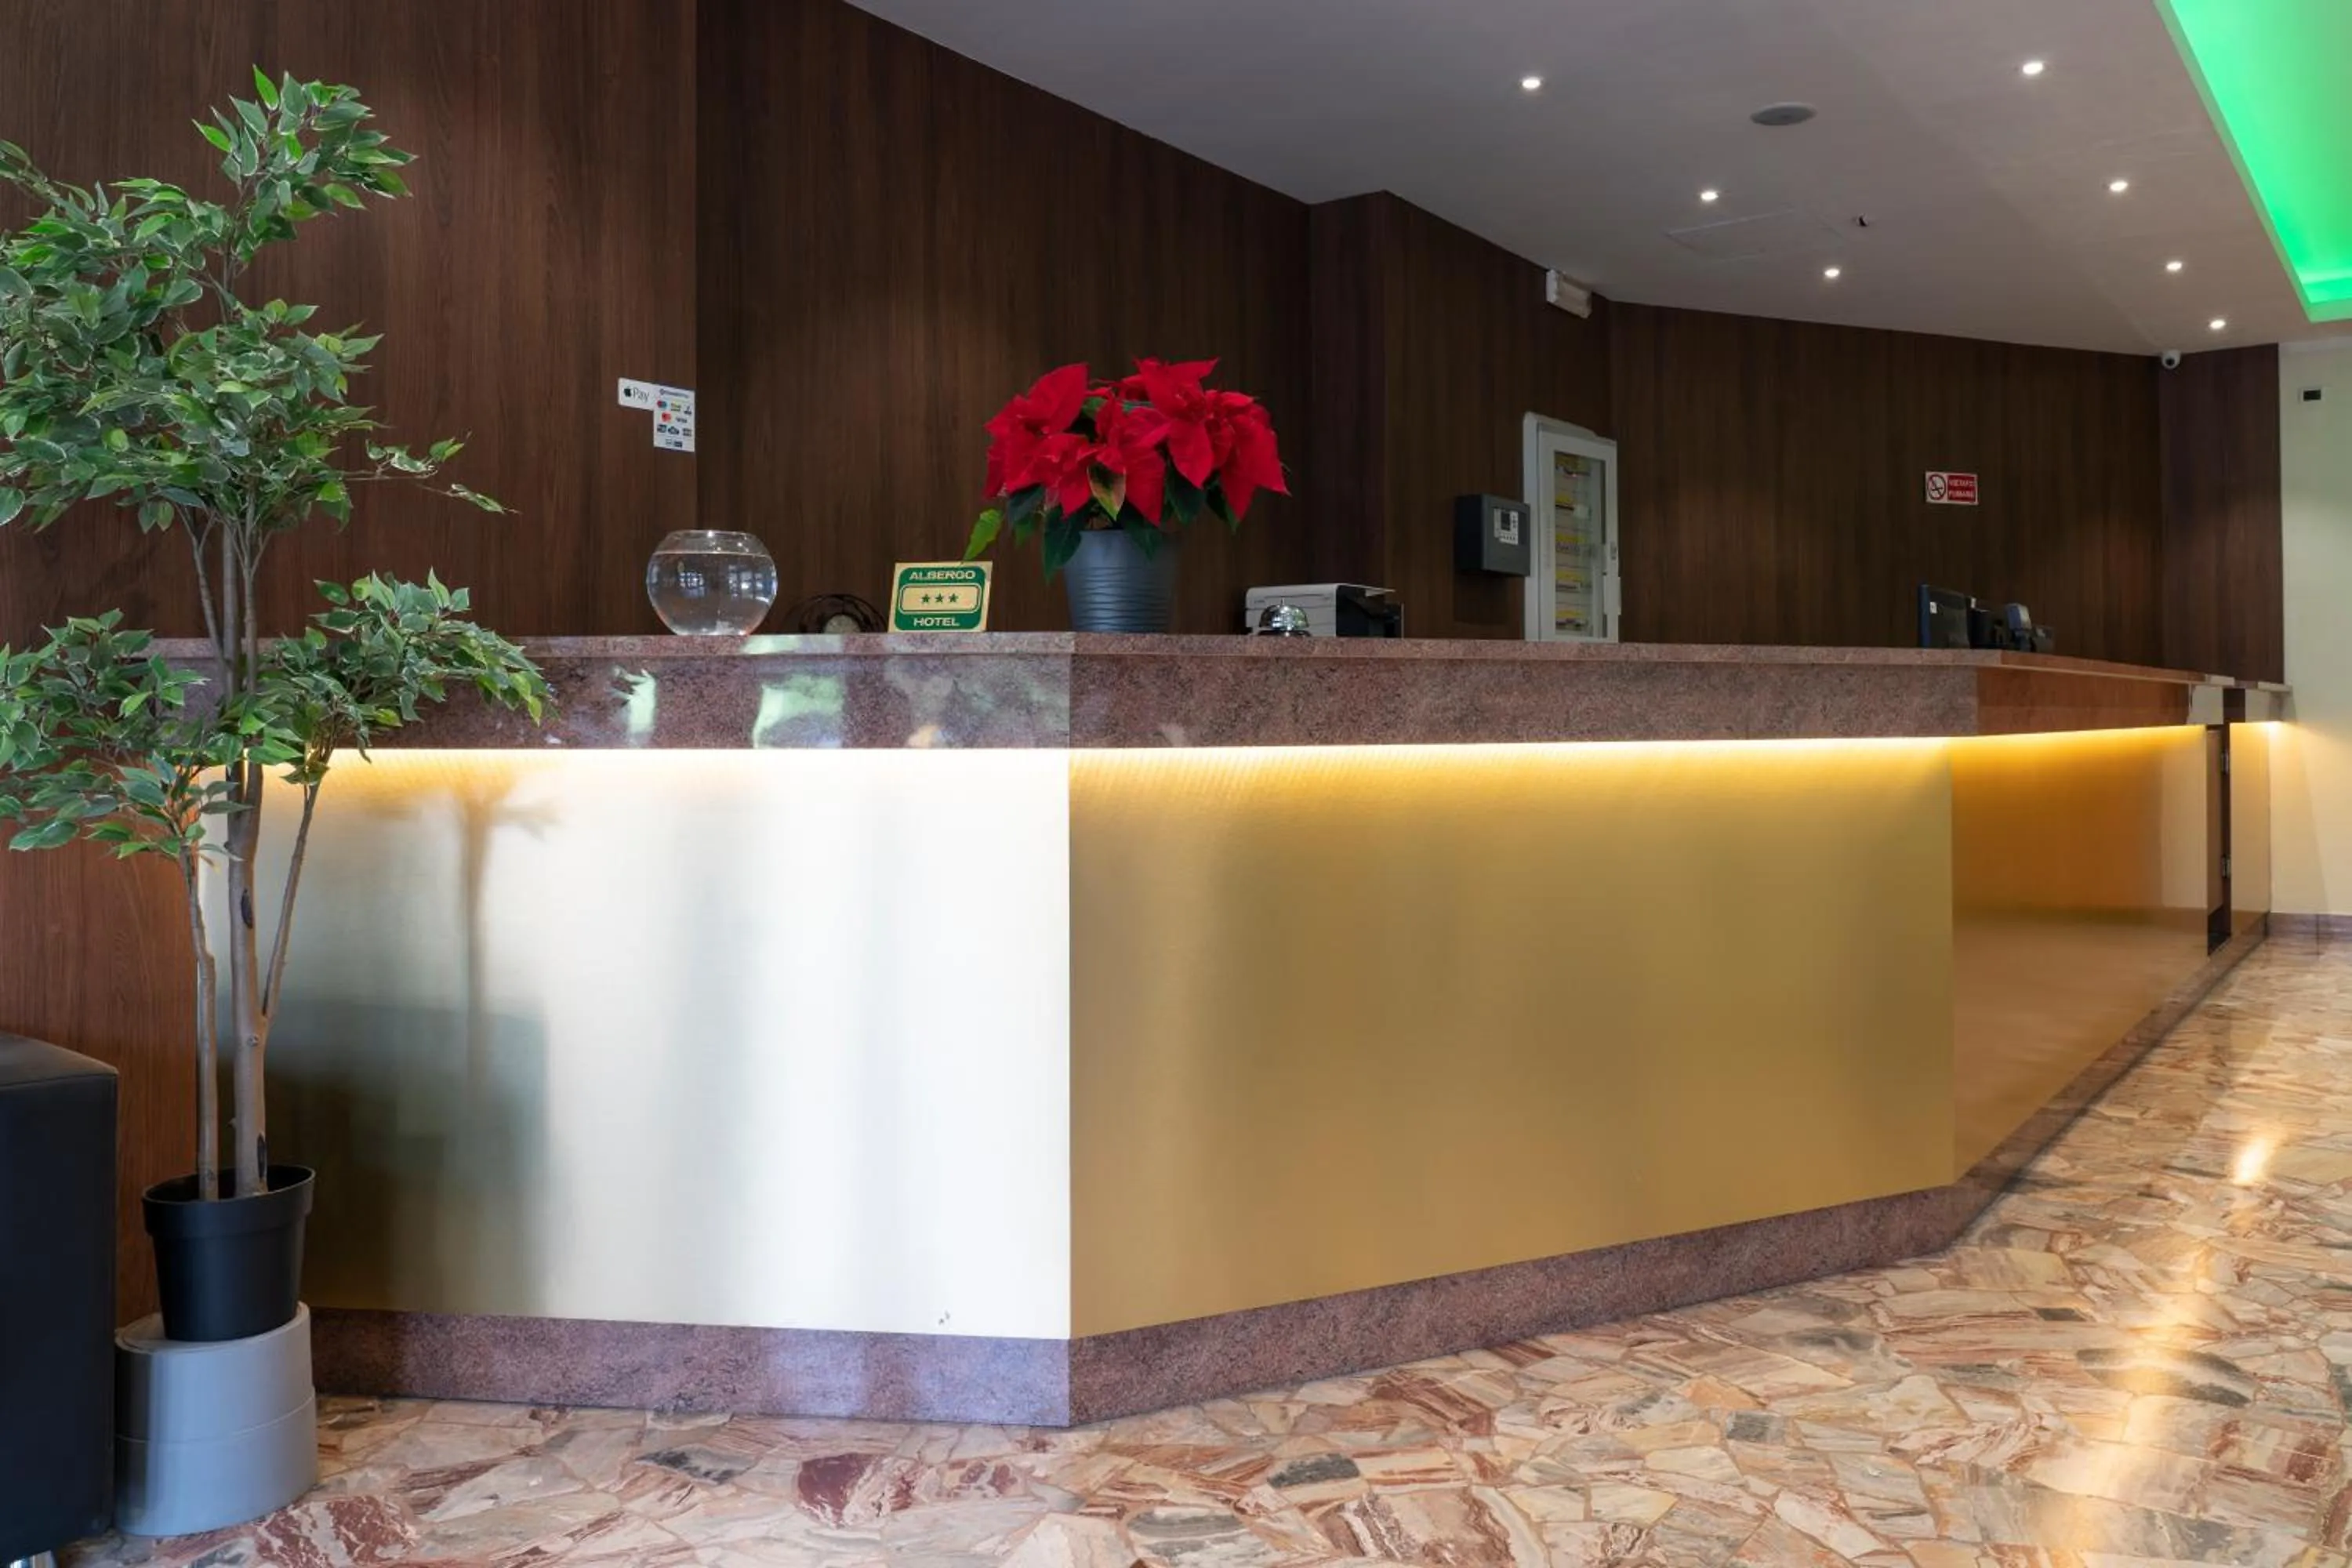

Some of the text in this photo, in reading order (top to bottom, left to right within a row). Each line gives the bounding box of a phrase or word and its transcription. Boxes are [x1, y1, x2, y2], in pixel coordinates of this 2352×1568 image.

[633, 387, 649, 402] Pay
[909, 570, 976, 580] ALBERGO
[913, 617, 960, 626] HOTEL
